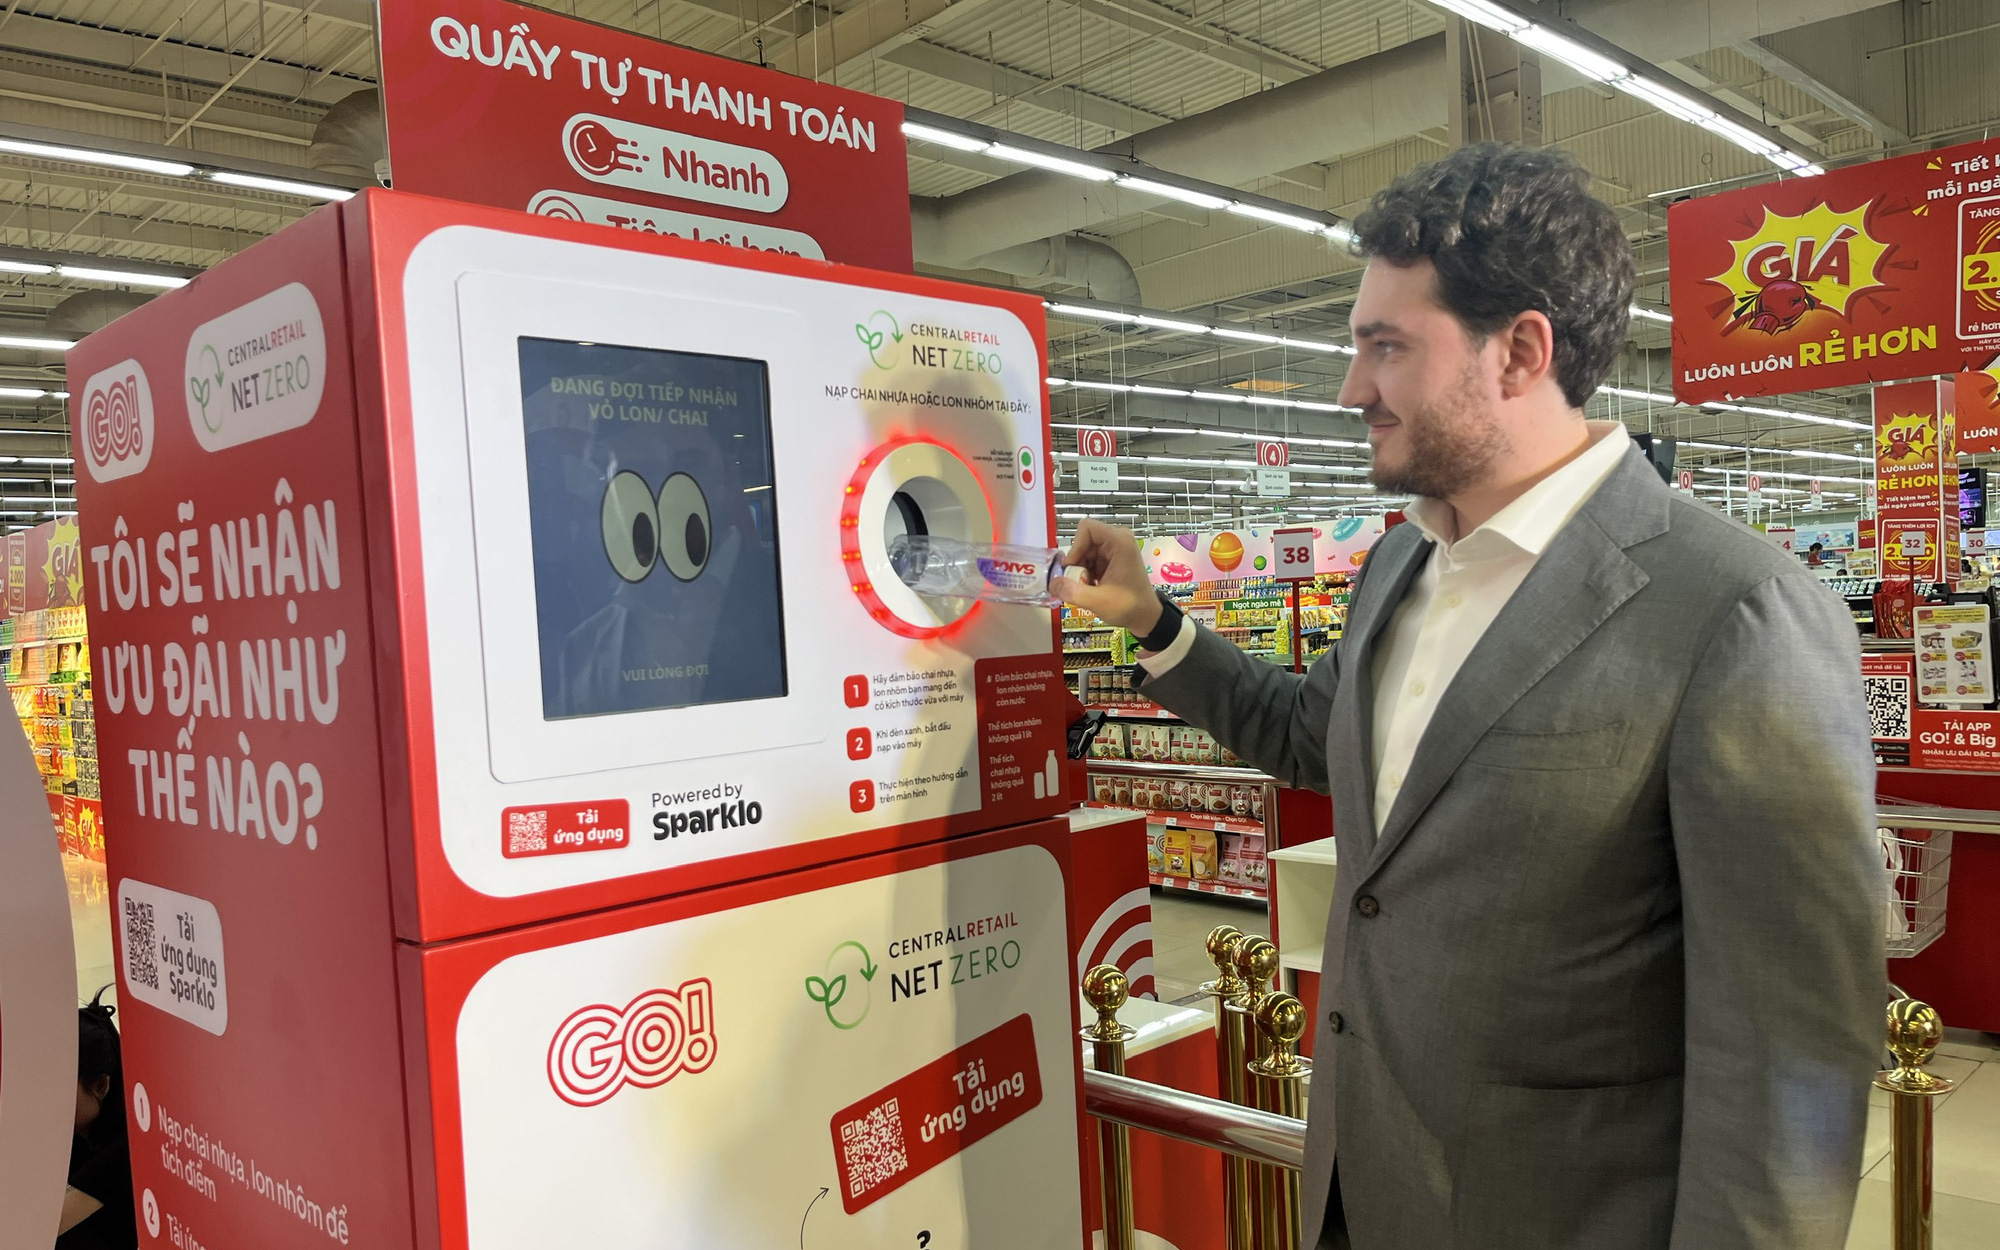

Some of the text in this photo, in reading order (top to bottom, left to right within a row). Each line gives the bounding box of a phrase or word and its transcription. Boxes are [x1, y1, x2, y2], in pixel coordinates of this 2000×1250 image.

[431, 16, 876, 153] QUẦY TỰ THANH TOÁN
[662, 146, 770, 198] Nhanh
[1951, 155, 1989, 175] Tiết
[1927, 180, 1962, 200] mỗi
[1742, 224, 1859, 287] GIÁ
[910, 323, 1000, 346] CENTRALRETAIL
[1968, 322, 1979, 332] rẻ
[227, 319, 307, 367] CENTRALRETAIL
[1684, 324, 1937, 383] LUÔN LUÔN RẺ HƠN
[913, 345, 1002, 374] NET ZERO
[230, 354, 310, 412] NET ZERO
[551, 377, 738, 410] ĐANG ĐỢI TIẾP NHẬN
[825, 385, 1031, 414] NẠP CHAI NHỰA HOẶC LON NHÔM TẠI ĐÂY:
[87, 374, 143, 467] GO!
[588, 399, 709, 426] VỎ LON/ CHAI
[1888, 424, 1927, 444] GIÁ
[1963, 427, 1998, 440] LUÔN
[1881, 462, 1934, 473] LUÔN LUÔN
[1877, 474, 1938, 490] RẺ HƠN
[91, 477, 341, 624] TÔI SẼ NHẬN
[1283, 547, 1309, 564] 38
[1905, 539, 1920, 548] 32
[1969, 540, 1983, 548] 30
[52, 537, 79, 583] GIÁ
[1232, 599, 1281, 610] Ngọt ngào mê
[102, 614, 346, 725] ƯU ĐÃI NHƯ
[623, 663, 709, 682] VUI LÒNG ĐỢI
[873, 669, 957, 685] Hãy đảm bảo chai nhựa,
[853, 684, 859, 699] 1
[874, 680, 957, 697] lon nhôm bạn mang đến
[875, 693, 964, 711] có kích thước vừa với máy
[876, 721, 951, 739] Khi đèn xanh, bắt đầu
[1943, 719, 1991, 731] TẢI APP
[855, 737, 864, 751] 2
[877, 739, 922, 754] nạp vào máy
[1920, 732, 1996, 748] GO! & Big
[1922, 748, 1944, 756] NHẬN
[128, 715, 324, 851] THẾ NÀO?
[879, 766, 969, 791] Thực hiện theo hướng dẫn
[651, 782, 743, 808] Powered by
[858, 789, 867, 803] 3
[880, 788, 928, 804] trên màn hình
[576, 809, 599, 825] Tải
[652, 799, 763, 841] Sparklo
[553, 825, 624, 845] ứng dụng
[177, 911, 195, 942] Tải
[888, 912, 1018, 959] CENTRALRETAIL
[161, 935, 184, 975] ứng
[890, 939, 1021, 1003] NET ZERO
[170, 971, 215, 1011] Sparklo
[547, 977, 717, 1107] GO!
[952, 1058, 987, 1096] Tải
[139, 1096, 146, 1120] 1
[919, 1071, 1026, 1143] ứng dụng
[158, 1104, 349, 1246] Nạp chai nhựa, lon nhôm để
[161, 1142, 217, 1203] tích điểm
[147, 1201, 155, 1226] 2
[166, 1213, 184, 1250] Tải
